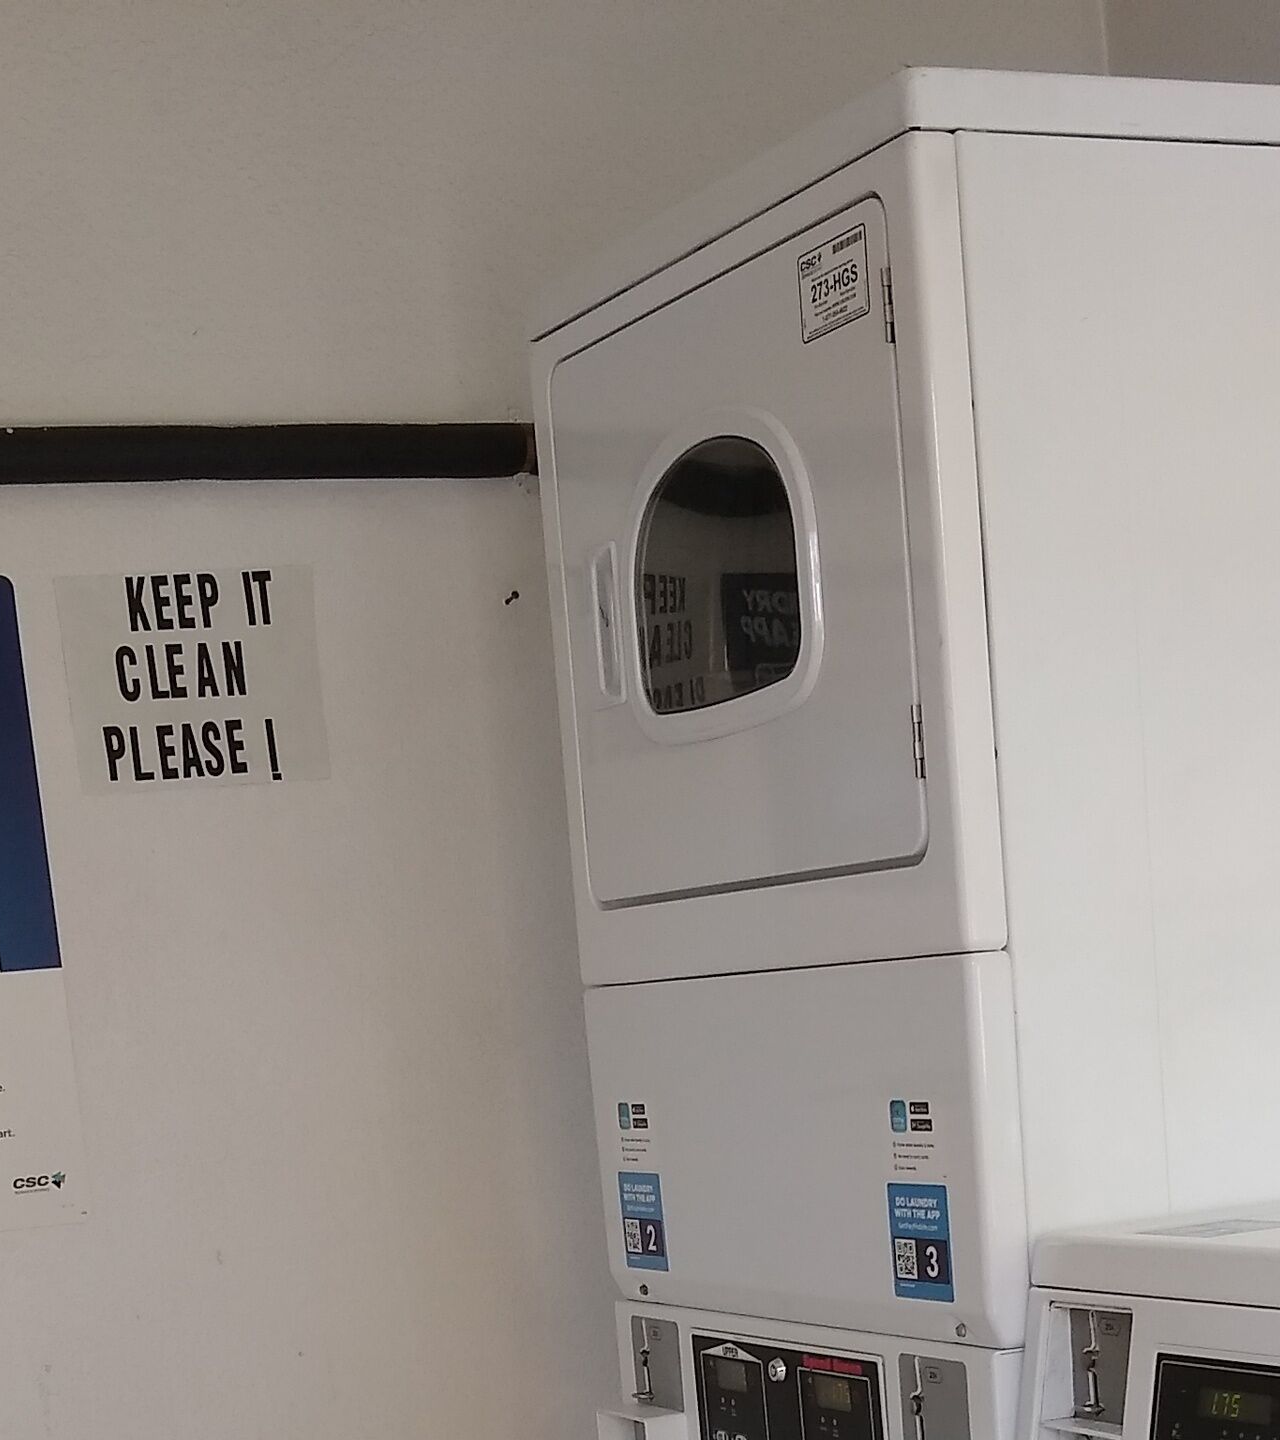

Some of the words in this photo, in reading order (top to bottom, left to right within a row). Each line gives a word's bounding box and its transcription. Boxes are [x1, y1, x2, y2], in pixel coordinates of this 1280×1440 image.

[810, 263, 859, 304] 273-HGS
[125, 572, 219, 632] KEEP
[241, 570, 272, 627] IT
[115, 640, 248, 702] CLEAN
[102, 718, 249, 782] PLEASE
[12, 1174, 50, 1190] CSC
[646, 1224, 657, 1251] 2
[925, 1244, 939, 1278] 3
[721, 1346, 739, 1358] UPPER
